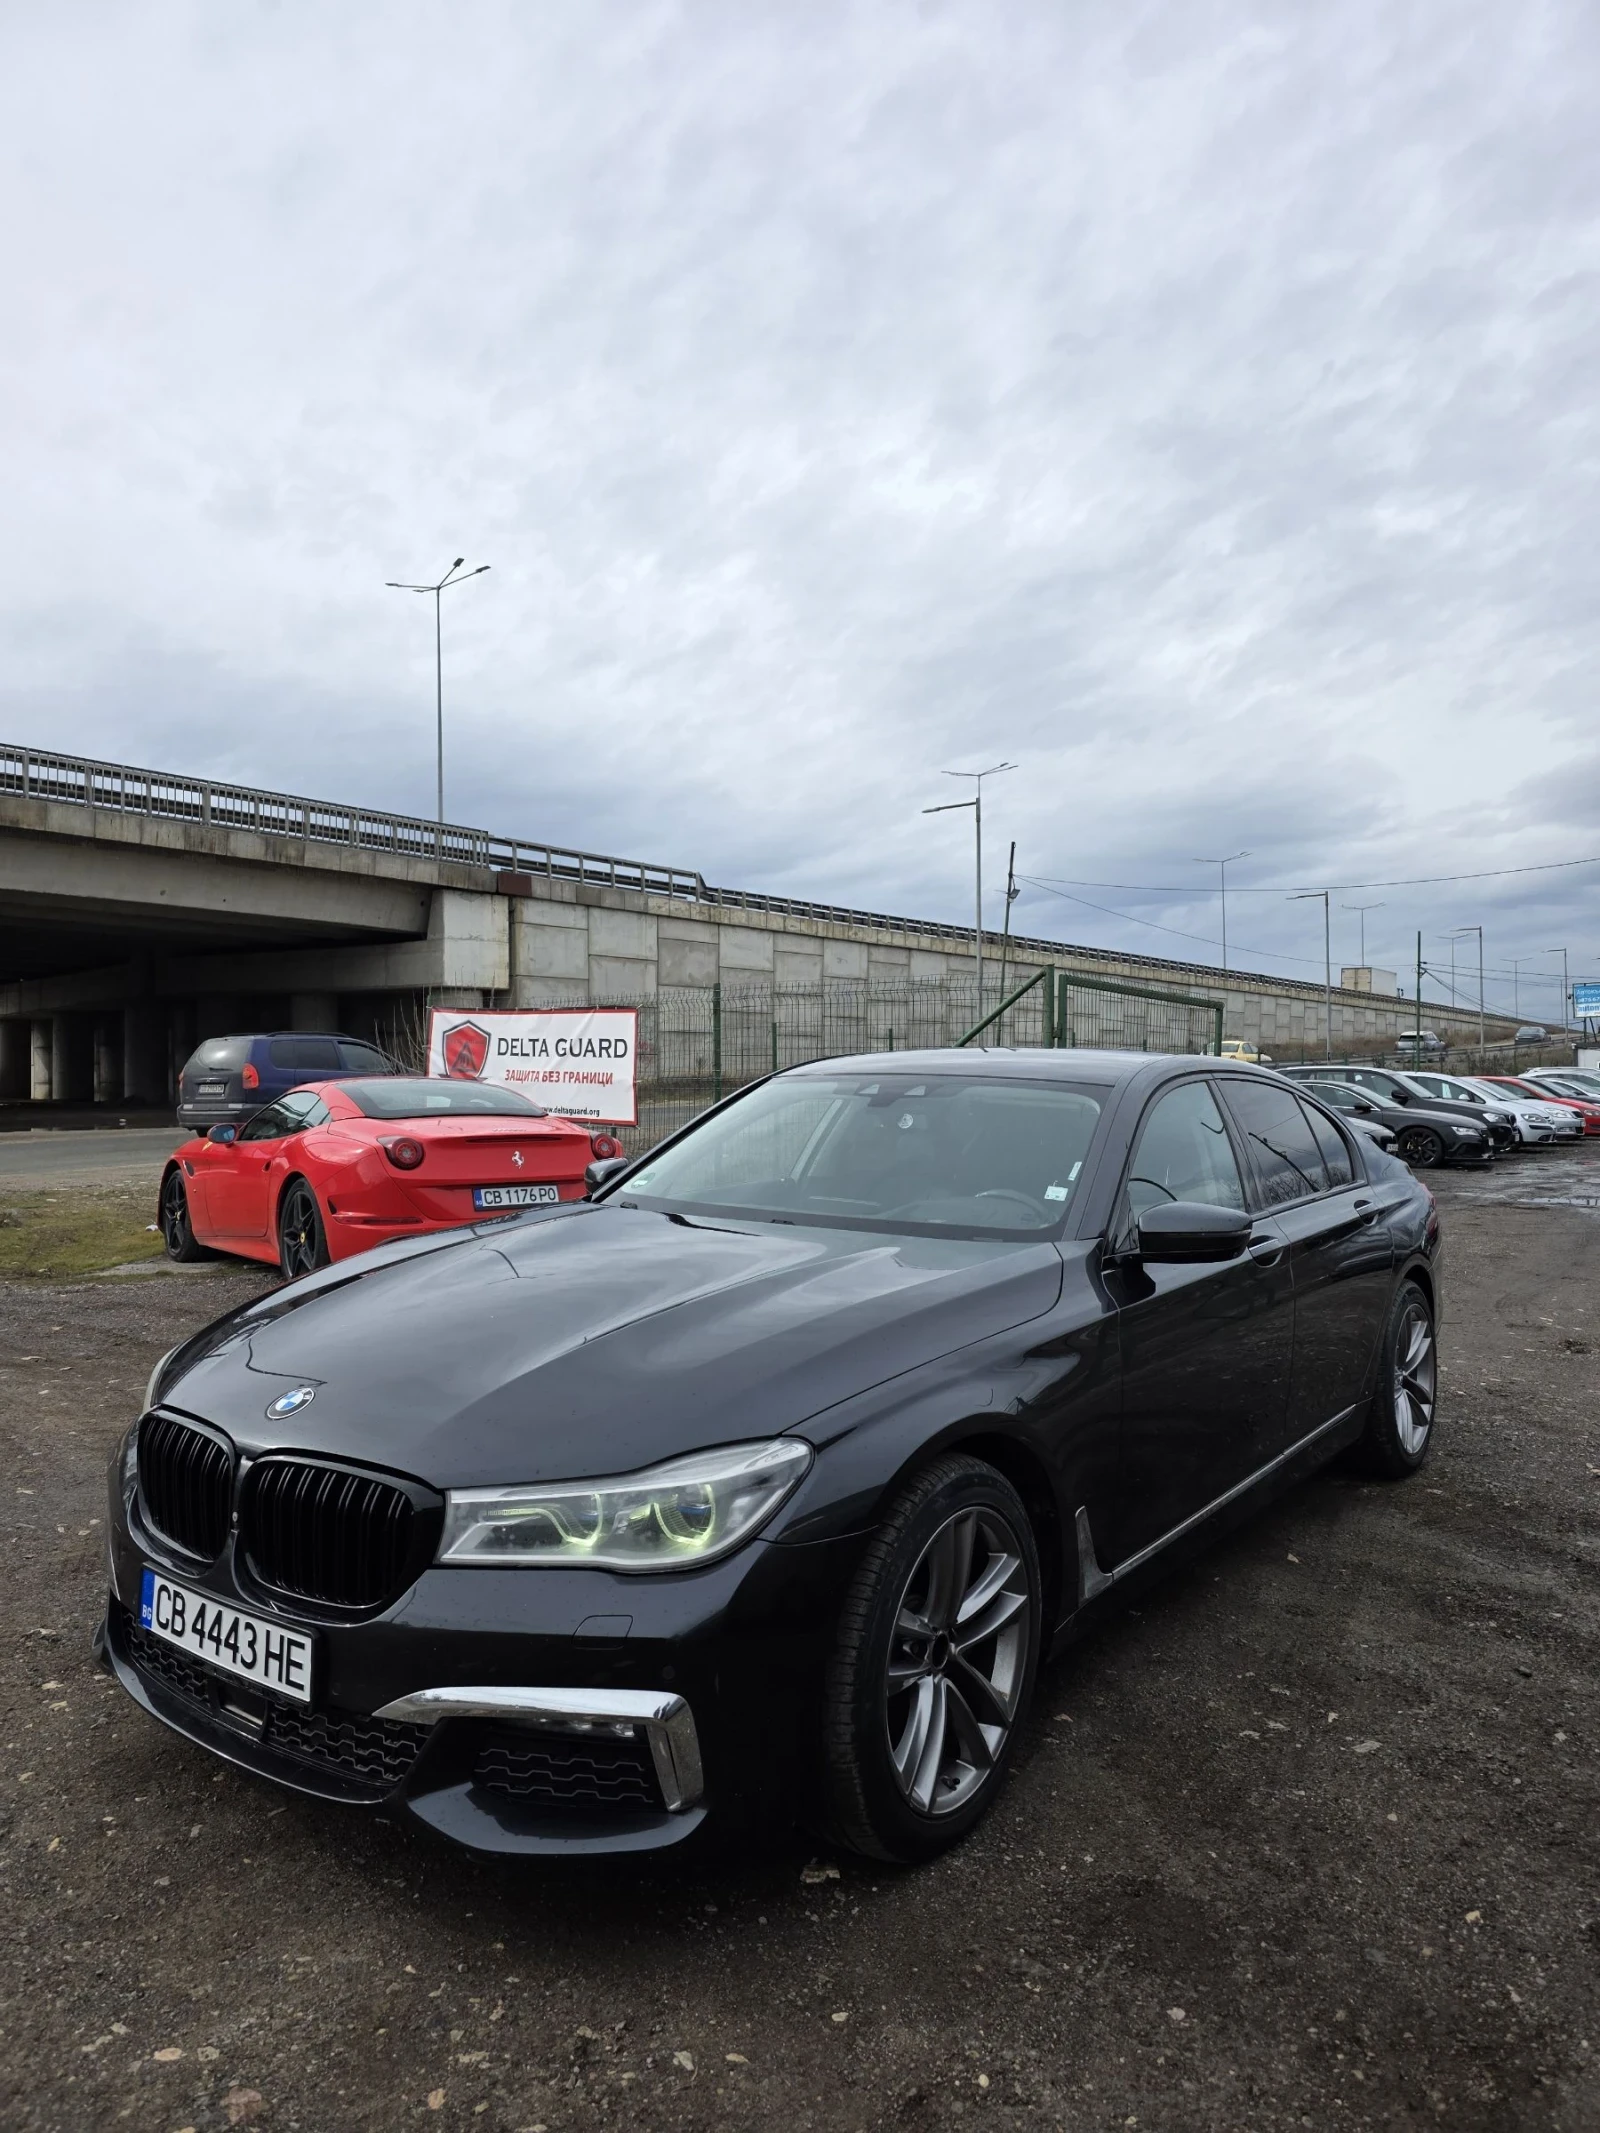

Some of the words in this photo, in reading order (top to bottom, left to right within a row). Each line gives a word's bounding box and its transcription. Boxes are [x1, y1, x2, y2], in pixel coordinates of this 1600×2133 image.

[497, 1037, 549, 1057] DELTA
[555, 1038, 628, 1058] GUARD
[504, 1069, 540, 1083] ЗАЩИТА
[541, 1070, 560, 1082] БЕЗ
[563, 1071, 613, 1087] ГРАНИЦИ
[484, 1190, 502, 1204] CB
[506, 1188, 537, 1203] 1176
[538, 1187, 556, 1201] PO
[141, 1604, 152, 1620] BG
[156, 1584, 186, 1638] CB
[191, 1602, 257, 1670] 4443
[264, 1629, 305, 1691] HE
